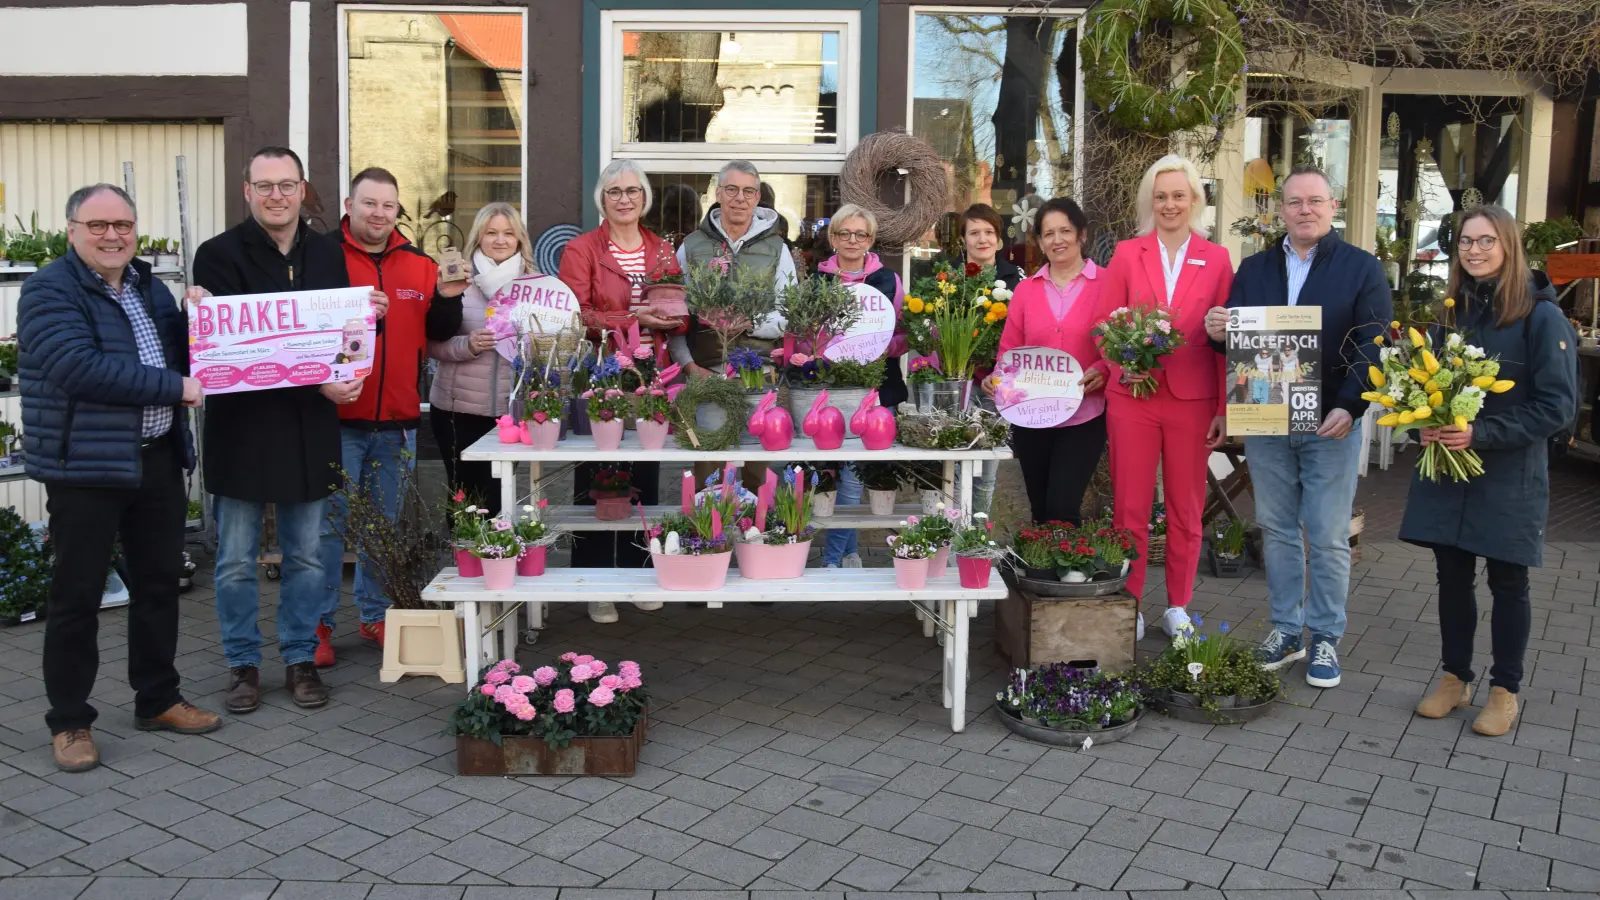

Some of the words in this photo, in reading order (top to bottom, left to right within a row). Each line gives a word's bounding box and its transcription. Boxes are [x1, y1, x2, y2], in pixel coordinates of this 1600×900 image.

[509, 283, 572, 312] BRAKEL
[859, 295, 886, 312] KEL
[197, 298, 305, 337] BRAKEL
[301, 295, 341, 312] ...blüht
[344, 296, 366, 316] auf
[837, 343, 856, 354] Wir
[857, 334, 878, 350] sind
[1012, 352, 1074, 374] BRAKEL
[1016, 371, 1052, 386] ...blüht
[1053, 378, 1073, 394] auf
[1017, 405, 1037, 416] Wir
[1038, 399, 1060, 414] sind
[1291, 392, 1318, 410] 08
[1026, 414, 1058, 426] dabei!
[1291, 411, 1318, 421] APR.
[1291, 422, 1318, 432] 2025
